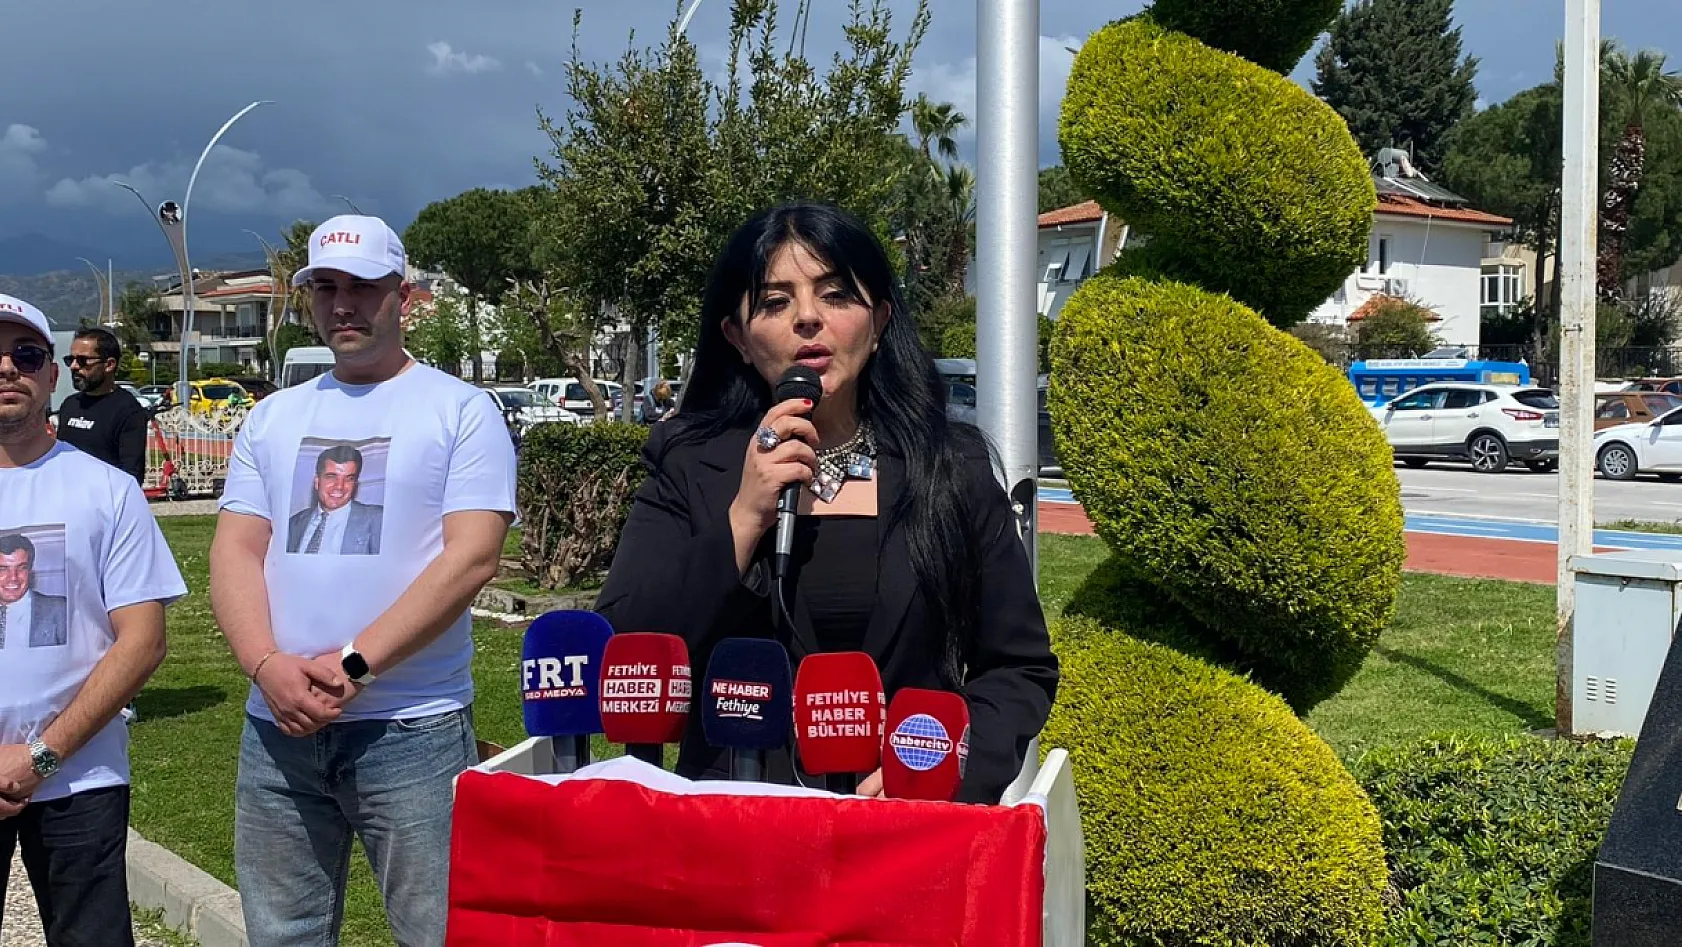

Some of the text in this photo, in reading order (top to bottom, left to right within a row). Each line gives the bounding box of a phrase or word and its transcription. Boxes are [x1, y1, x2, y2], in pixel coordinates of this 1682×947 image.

[320, 231, 361, 249] ÇATLI
[523, 655, 588, 691] FRT
[607, 662, 658, 676] FETHİYE
[542, 688, 585, 698] MEDYA
[607, 681, 656, 694] HABER
[806, 688, 870, 707] FETHİYE
[602, 699, 660, 713] MERKEZİ
[716, 696, 760, 717] Fethiye
[811, 707, 866, 723] HABER
[807, 721, 871, 738] BÜLTENİ
